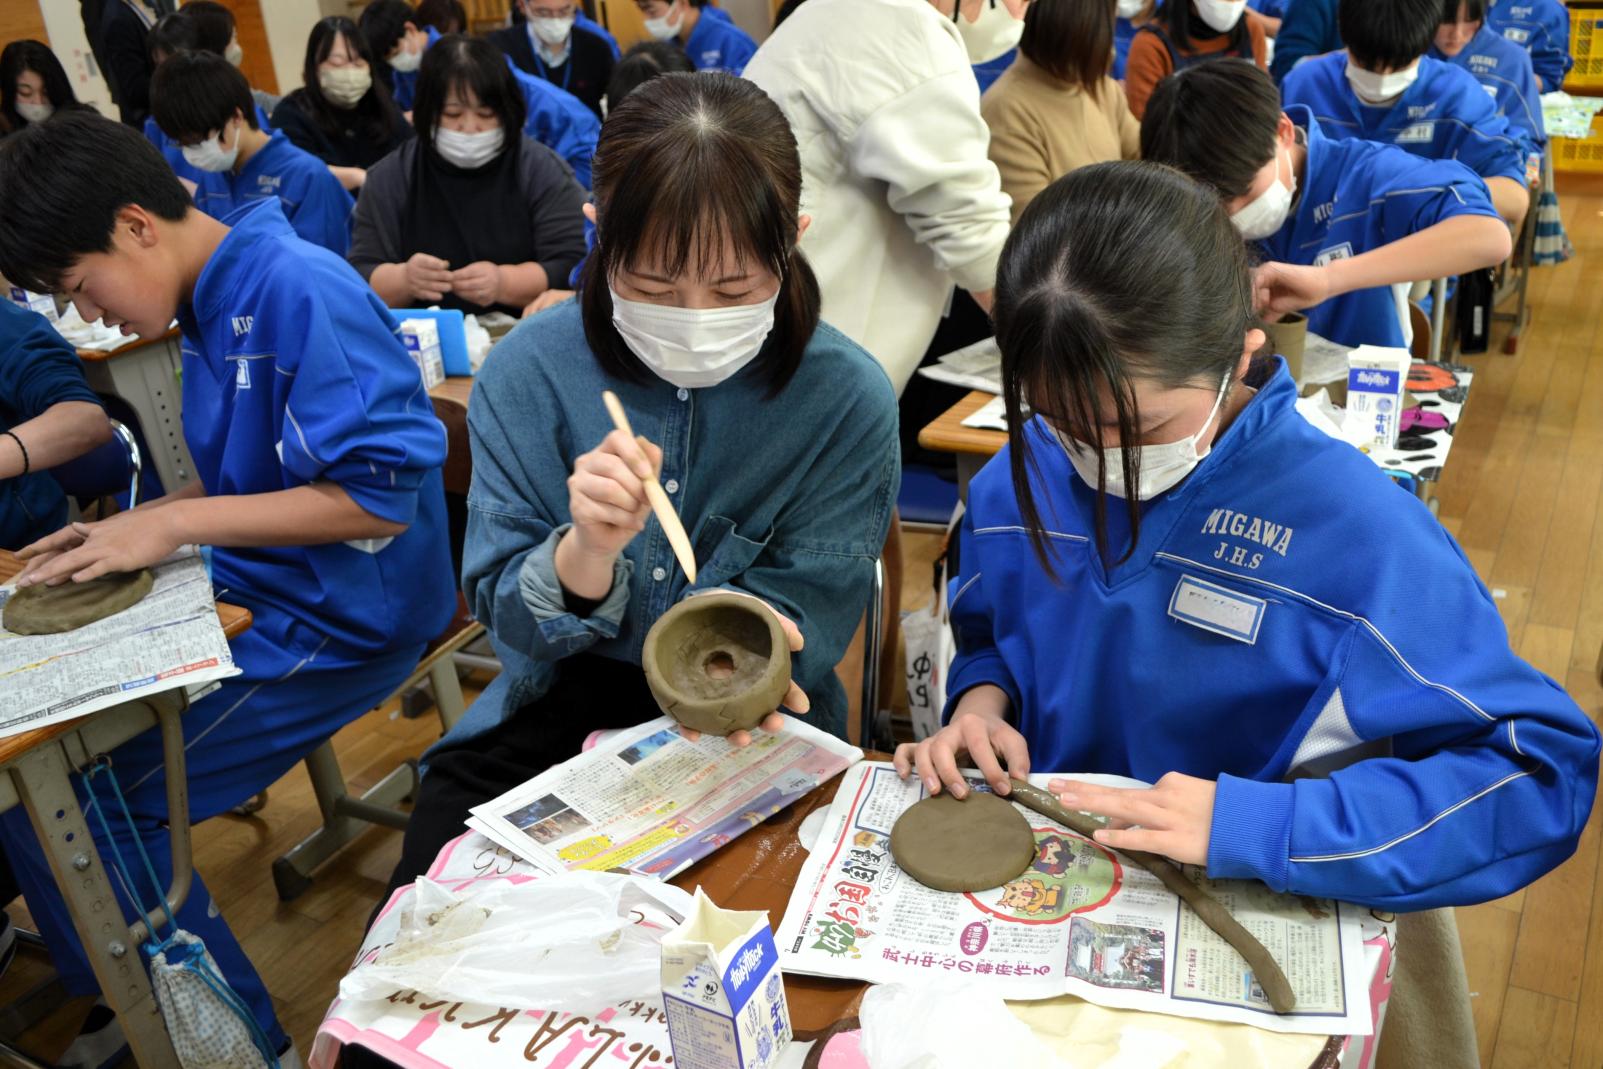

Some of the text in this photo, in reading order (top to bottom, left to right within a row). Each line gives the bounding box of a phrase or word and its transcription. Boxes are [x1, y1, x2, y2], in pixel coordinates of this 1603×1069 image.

[1201, 508, 1294, 557] MIGAWA
[1214, 541, 1264, 570] J.H.S
[882, 946, 1051, 977] 武士中心の幕府作る
[770, 1000, 784, 1038] 牛乳
